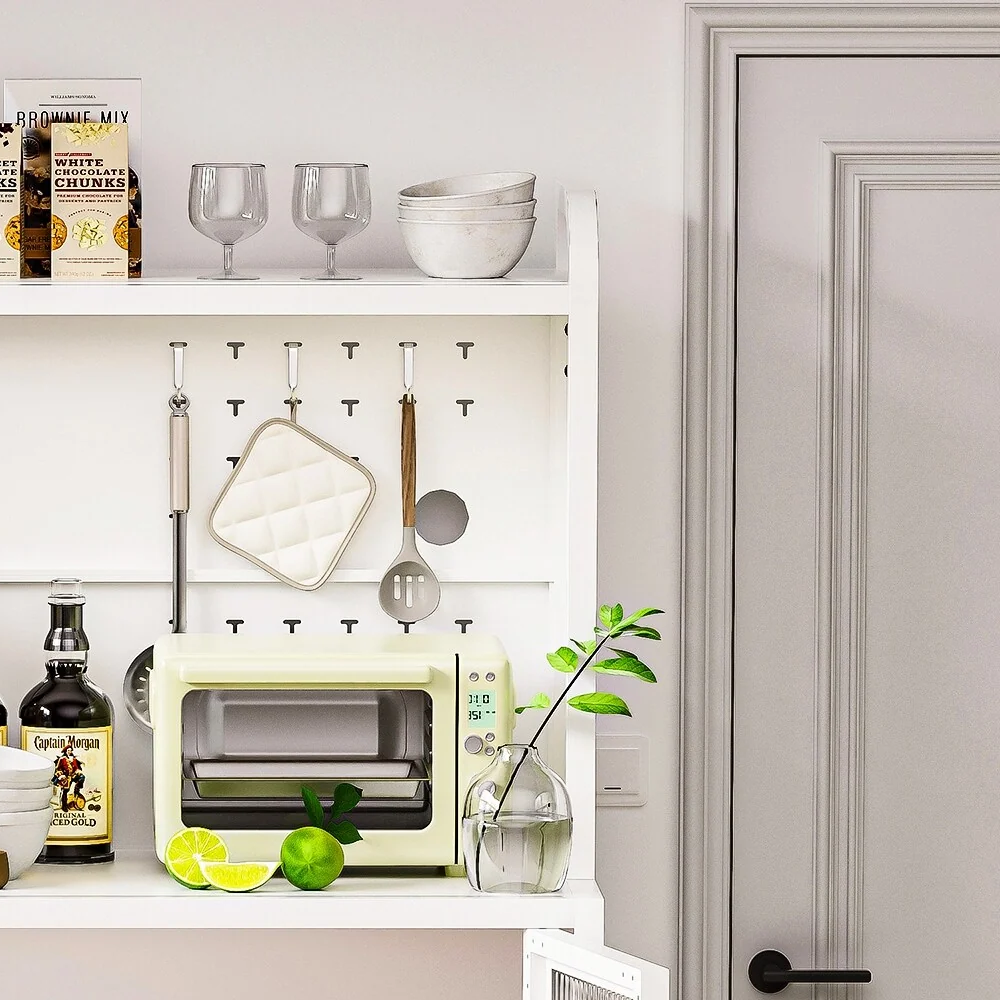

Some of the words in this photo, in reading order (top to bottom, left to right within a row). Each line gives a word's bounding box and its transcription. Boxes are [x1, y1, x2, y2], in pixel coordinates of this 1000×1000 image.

[100, 111, 129, 124] MIX
[54, 158, 104, 167] WHITE
[54, 168, 126, 176] CHOCOLATE
[54, 177, 126, 188] CHUNKS
[34, 736, 66, 751] Captain
[66, 735, 100, 751] Morgan
[50, 818, 70, 826] CED
[71, 818, 96, 827] GOLD
